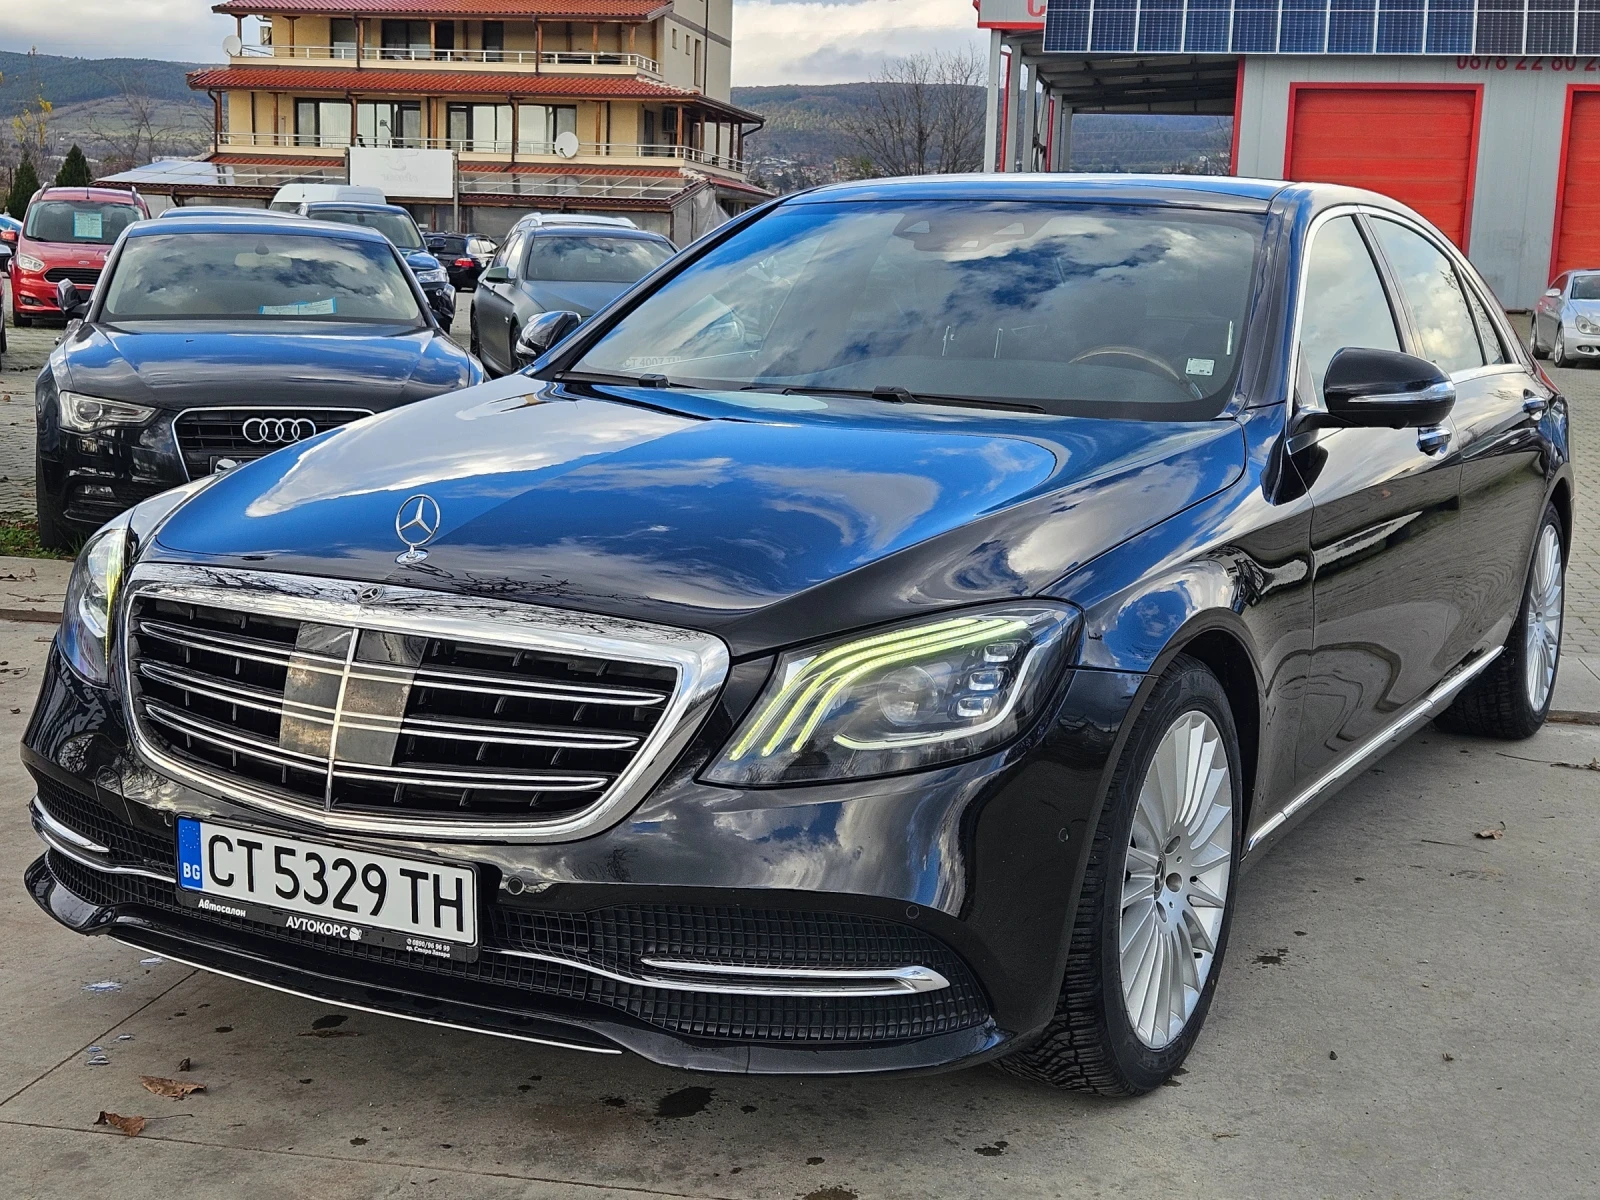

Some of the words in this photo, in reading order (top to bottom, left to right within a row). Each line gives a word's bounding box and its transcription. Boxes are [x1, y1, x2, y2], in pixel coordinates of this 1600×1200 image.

[183, 862, 200, 880] BG
[208, 834, 263, 893] CT
[274, 845, 388, 917] 5329
[399, 868, 464, 933] TH
[198, 898, 246, 918] Автосалон
[285, 915, 349, 938] АУТОКОРС
